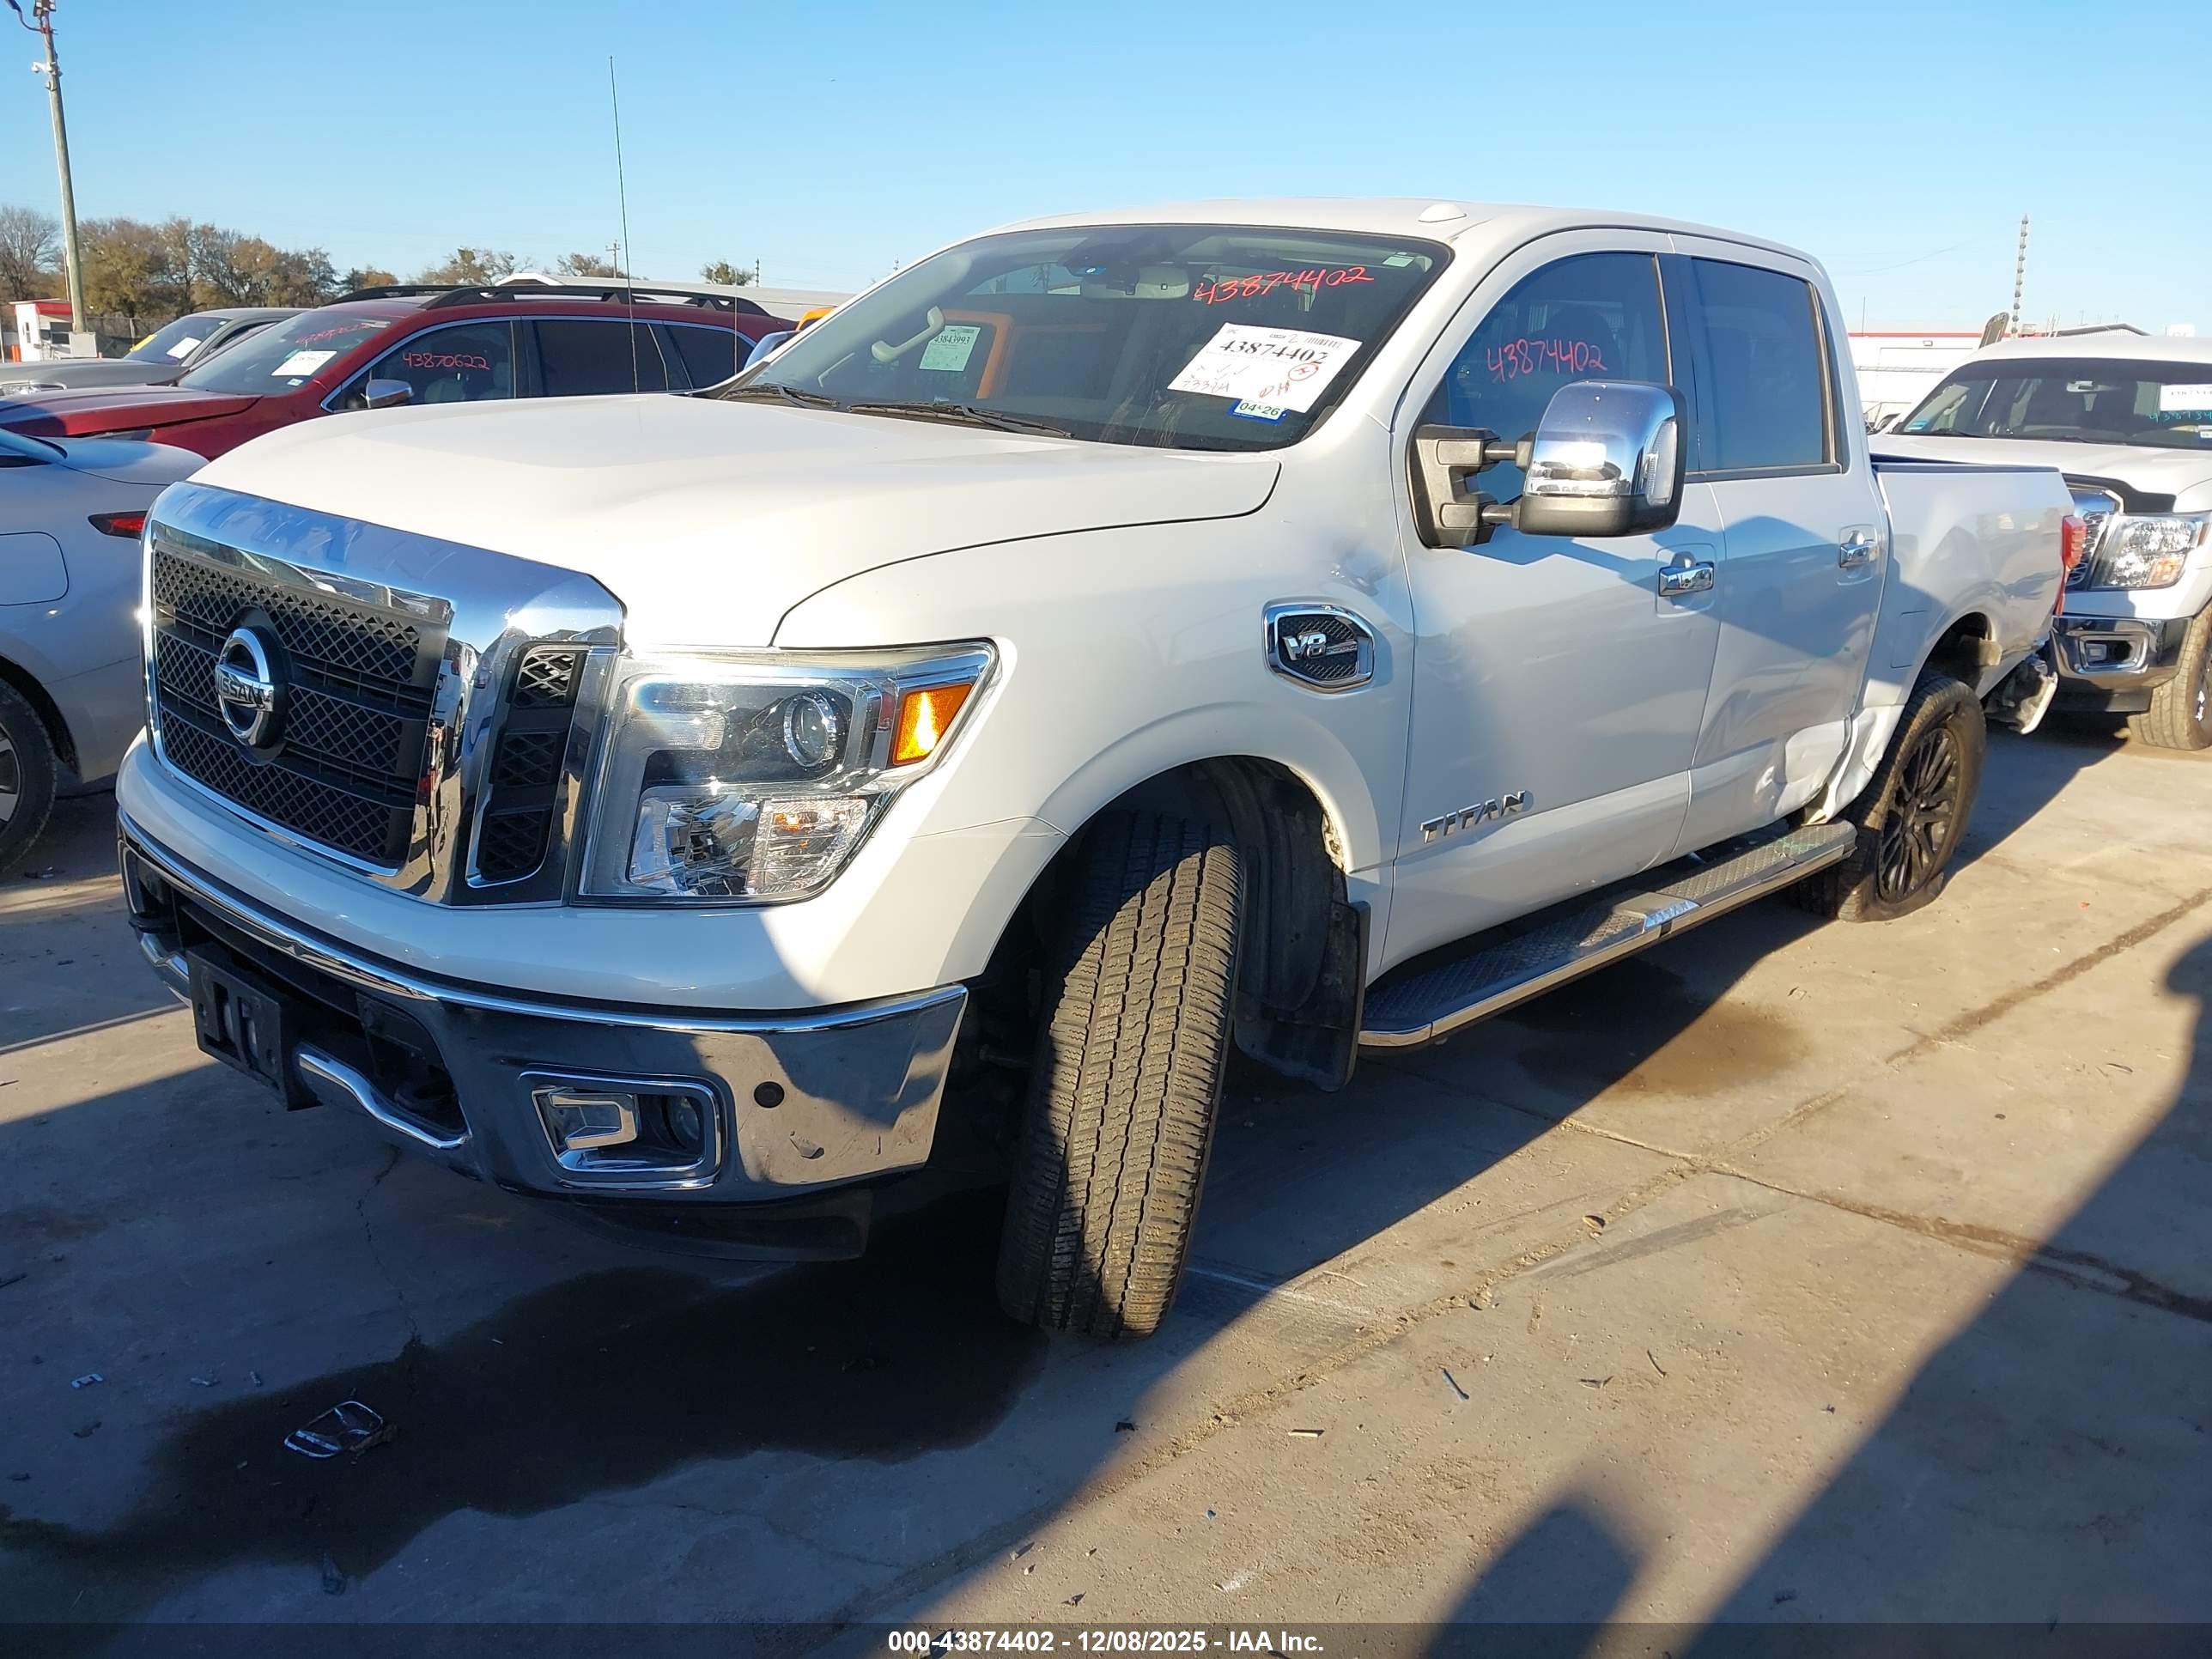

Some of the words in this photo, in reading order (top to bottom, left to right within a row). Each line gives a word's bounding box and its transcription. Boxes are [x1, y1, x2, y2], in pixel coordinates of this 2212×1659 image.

[1194, 266, 1374, 304] 43874402
[402, 351, 491, 371] 43870622
[1219, 339, 1328, 365] 43874402
[1486, 338, 1608, 383] 43874402
[1239, 402, 1258, 412] 04
[1261, 405, 1281, 416] 26
[1282, 632, 1326, 660] V8
[216, 671, 266, 708] NISSAN
[1419, 790, 1526, 843] TITAN
